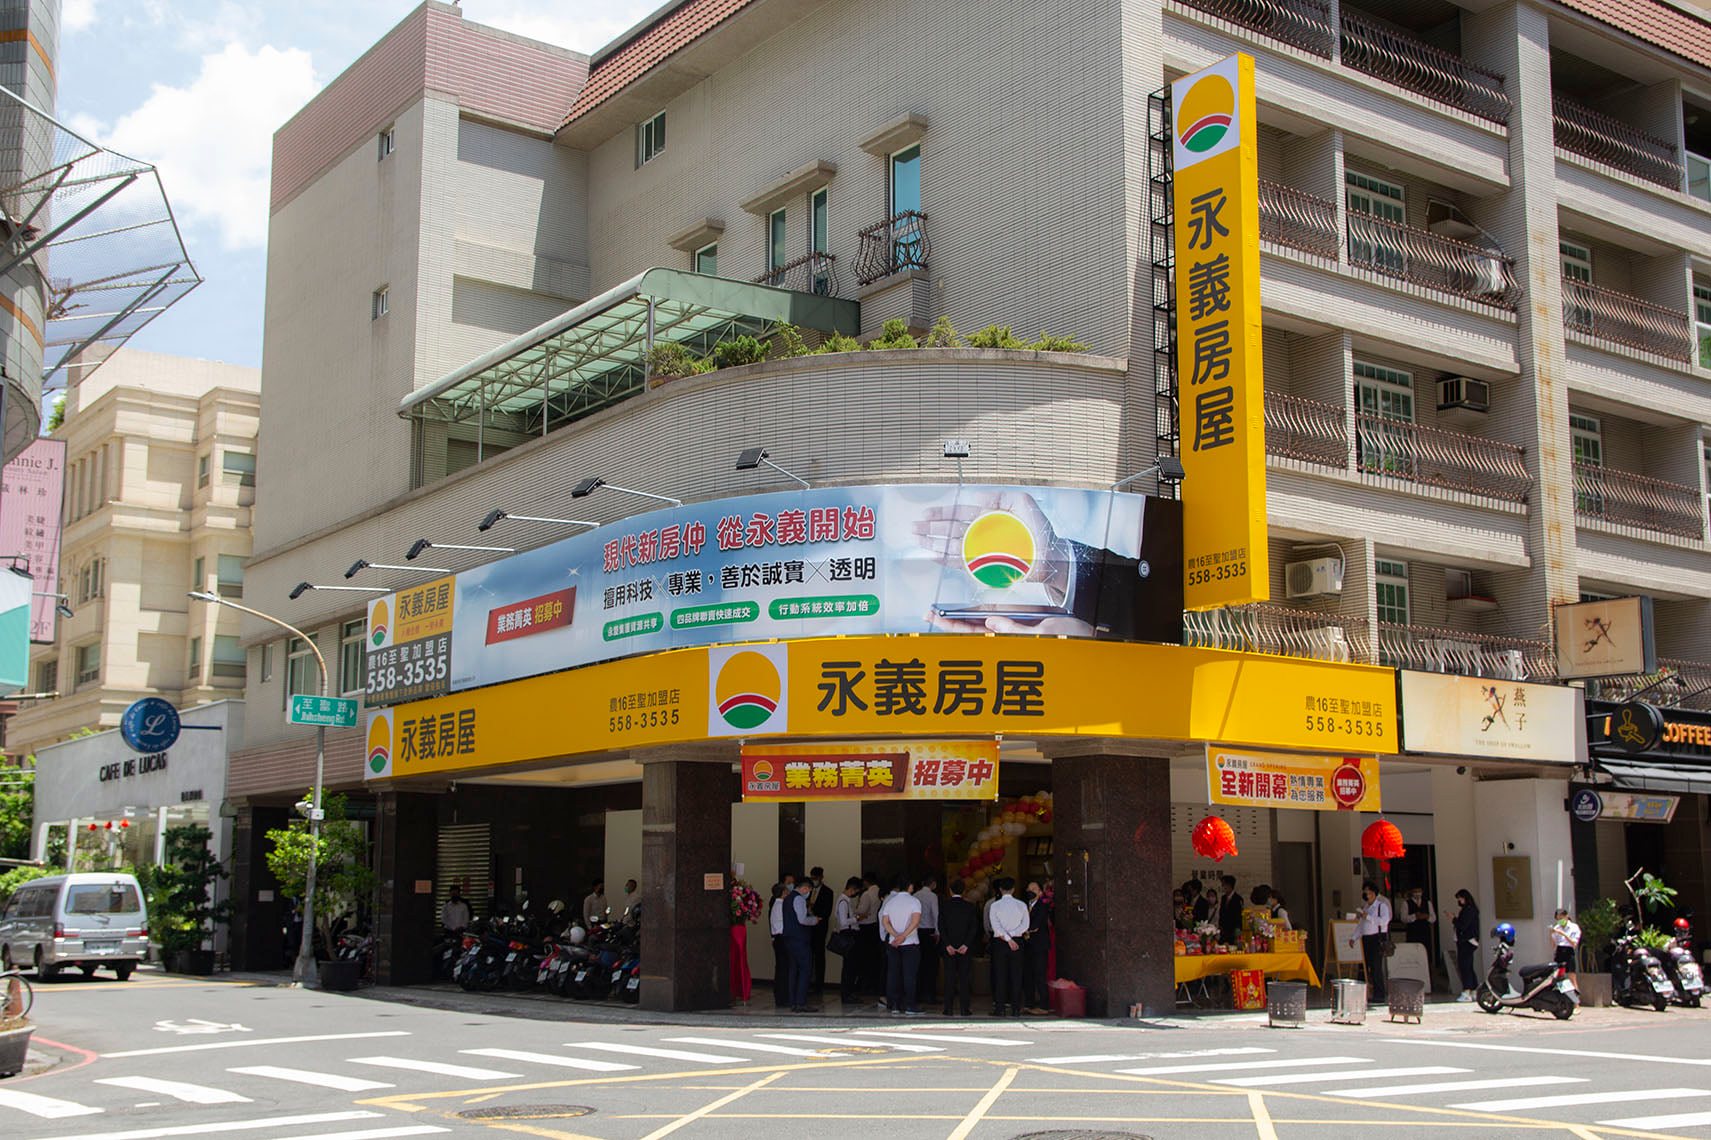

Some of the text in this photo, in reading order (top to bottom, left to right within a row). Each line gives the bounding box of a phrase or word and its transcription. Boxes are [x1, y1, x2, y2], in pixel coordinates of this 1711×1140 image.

[1187, 187, 1234, 453] 永義房屋
[13, 456, 42, 468] nnie
[603, 505, 876, 573] 現代新房仲 從永義開始
[829, 556, 876, 582] 透明
[1188, 562, 1246, 586] 558-3535
[400, 583, 450, 620] 永義房屋
[778, 600, 870, 616] 行動系統效率加倍
[496, 600, 563, 634] 業務菁英 招募中
[367, 655, 447, 694] 558-3535
[817, 658, 1046, 717] 永義房屋
[609, 688, 681, 713] 農16至聖加盟店
[1305, 696, 1383, 718] 農16至聖加盟店
[1514, 687, 1527, 731] 燕子
[609, 708, 680, 733] 558-3535
[1306, 715, 1383, 737] 558-3535
[400, 708, 476, 763] 永義房屋
[139, 752, 167, 775] LUCAS
[785, 759, 994, 789] 業務菁英 招募中
[748, 782, 780, 791] 永義房屋
[1221, 770, 1287, 800] 全新開幕
